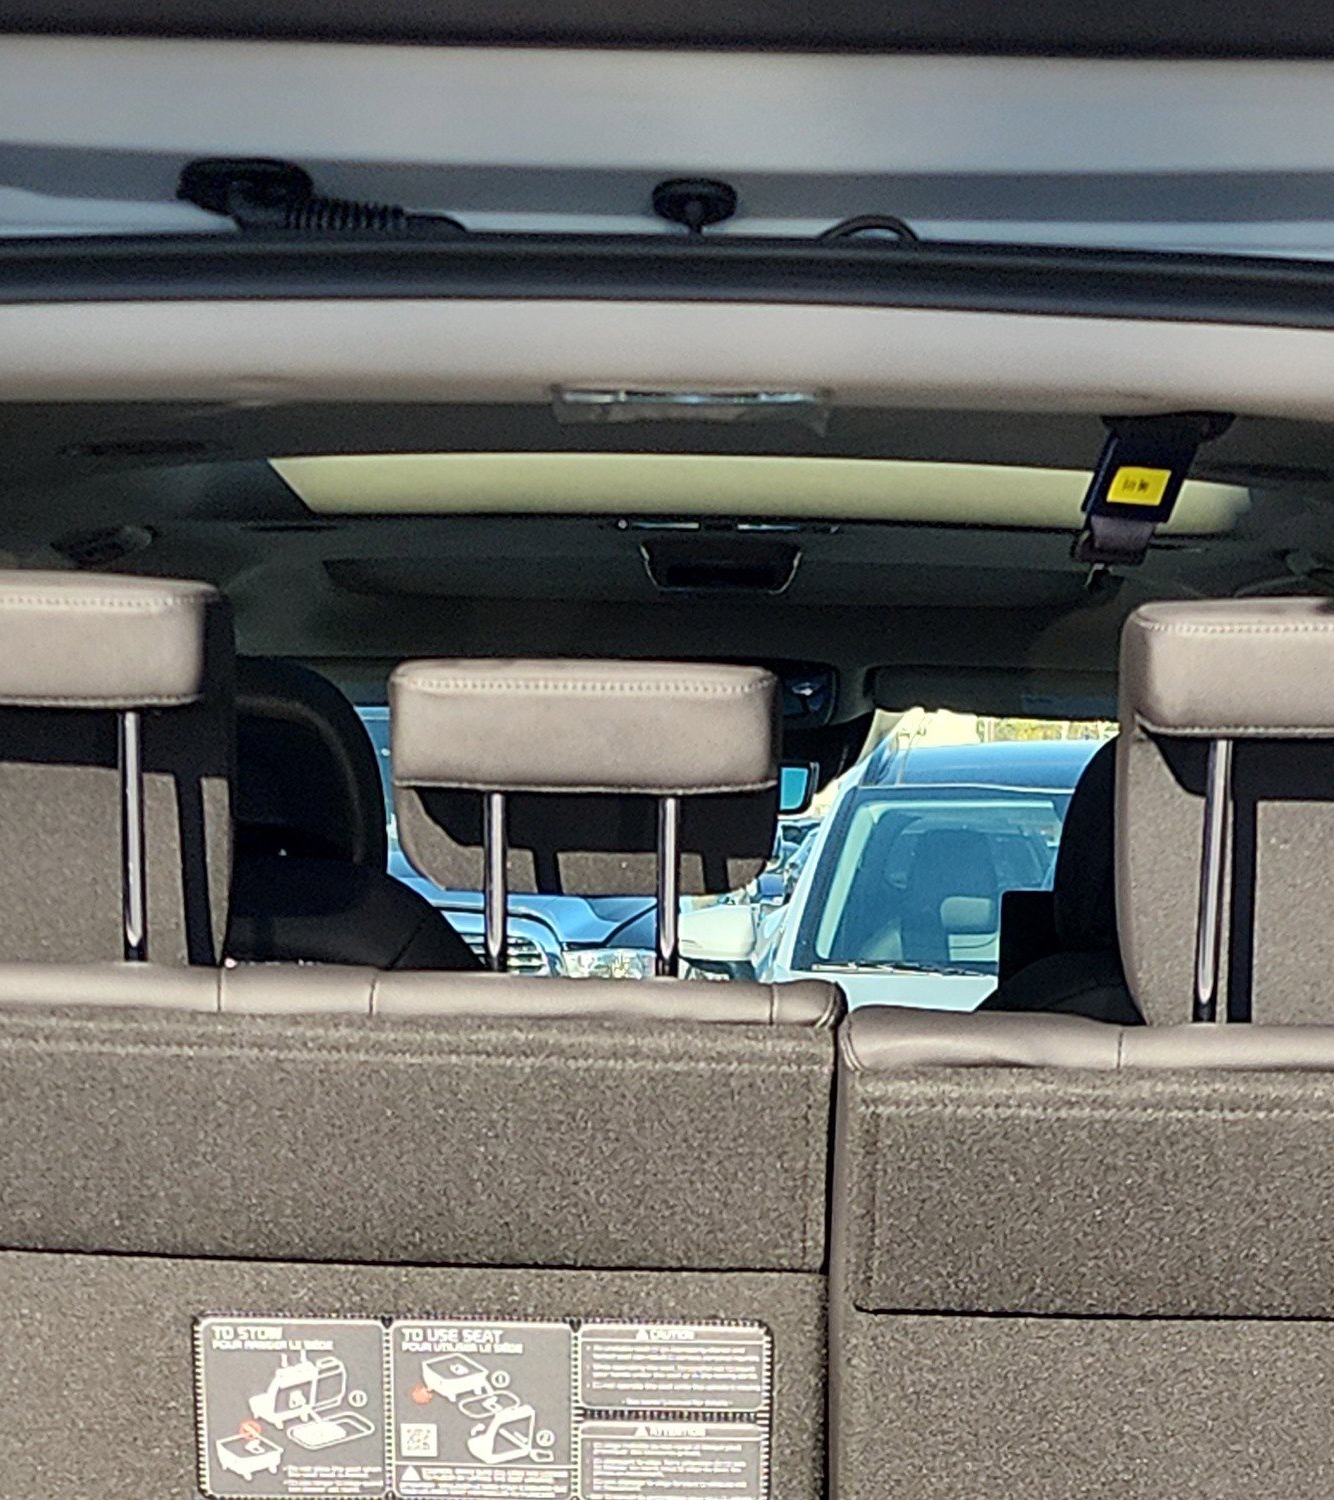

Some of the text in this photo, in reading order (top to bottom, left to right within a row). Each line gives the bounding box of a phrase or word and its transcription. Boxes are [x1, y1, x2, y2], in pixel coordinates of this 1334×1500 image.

[212, 1326, 234, 1340] TO
[401, 1328, 504, 1344] TO USE SEAT
